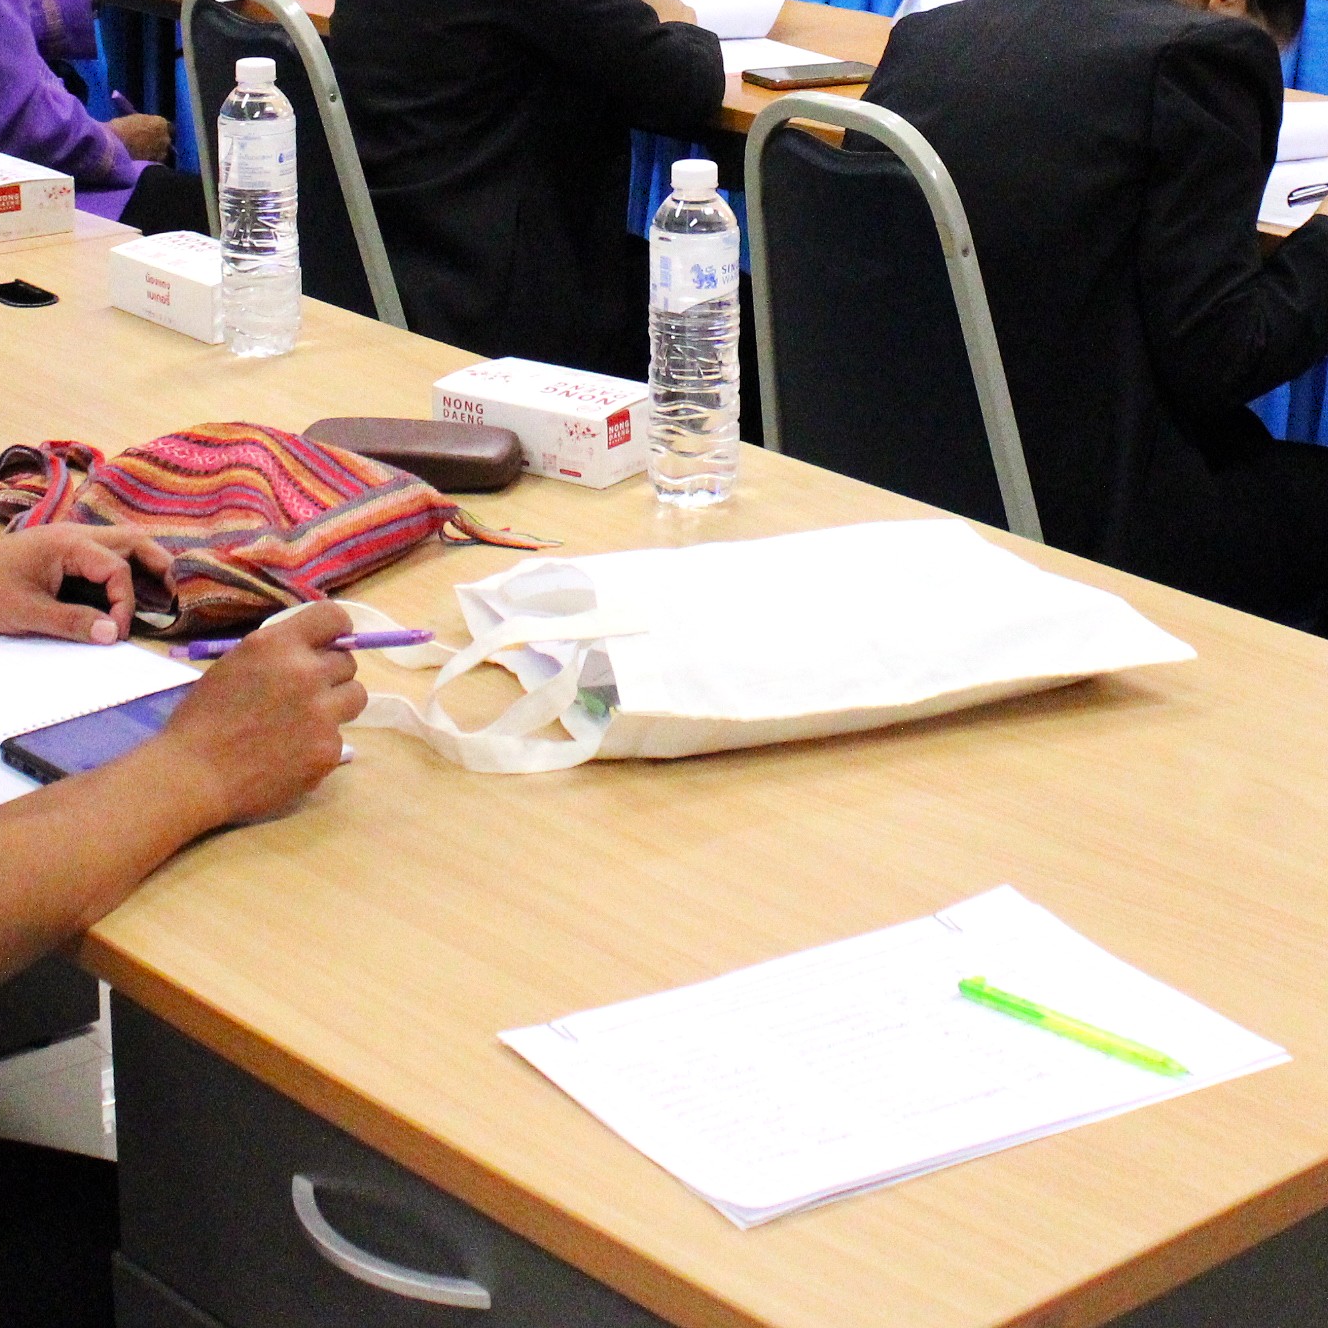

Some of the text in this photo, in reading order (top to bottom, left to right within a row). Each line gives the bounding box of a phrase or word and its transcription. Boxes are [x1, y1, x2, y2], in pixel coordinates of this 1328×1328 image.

[443, 395, 484, 415] NONG
[443, 408, 484, 425] DAENG
[608, 420, 630, 435] NONG
